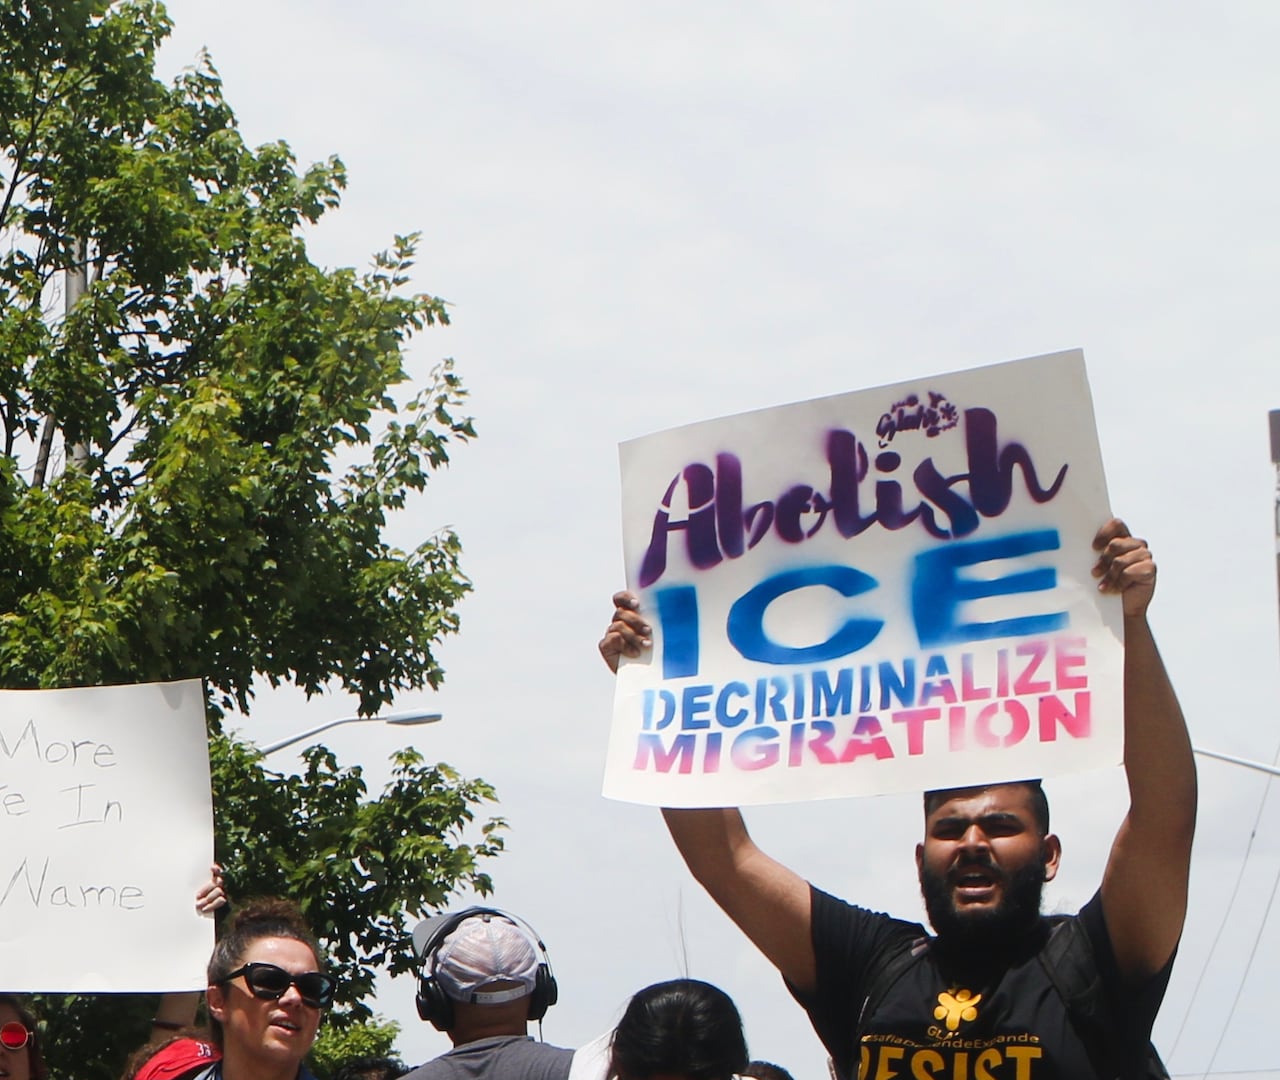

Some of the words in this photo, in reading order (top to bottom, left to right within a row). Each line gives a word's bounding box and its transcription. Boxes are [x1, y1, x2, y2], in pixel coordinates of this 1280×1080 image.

[638, 406, 1070, 590] Abolish
[651, 527, 1072, 681] ICE
[640, 635, 1089, 732] DECRIMINALIZE
[632, 689, 1093, 775] MIGRATION
[56, 782, 124, 830] In
[0, 855, 146, 911] Name
